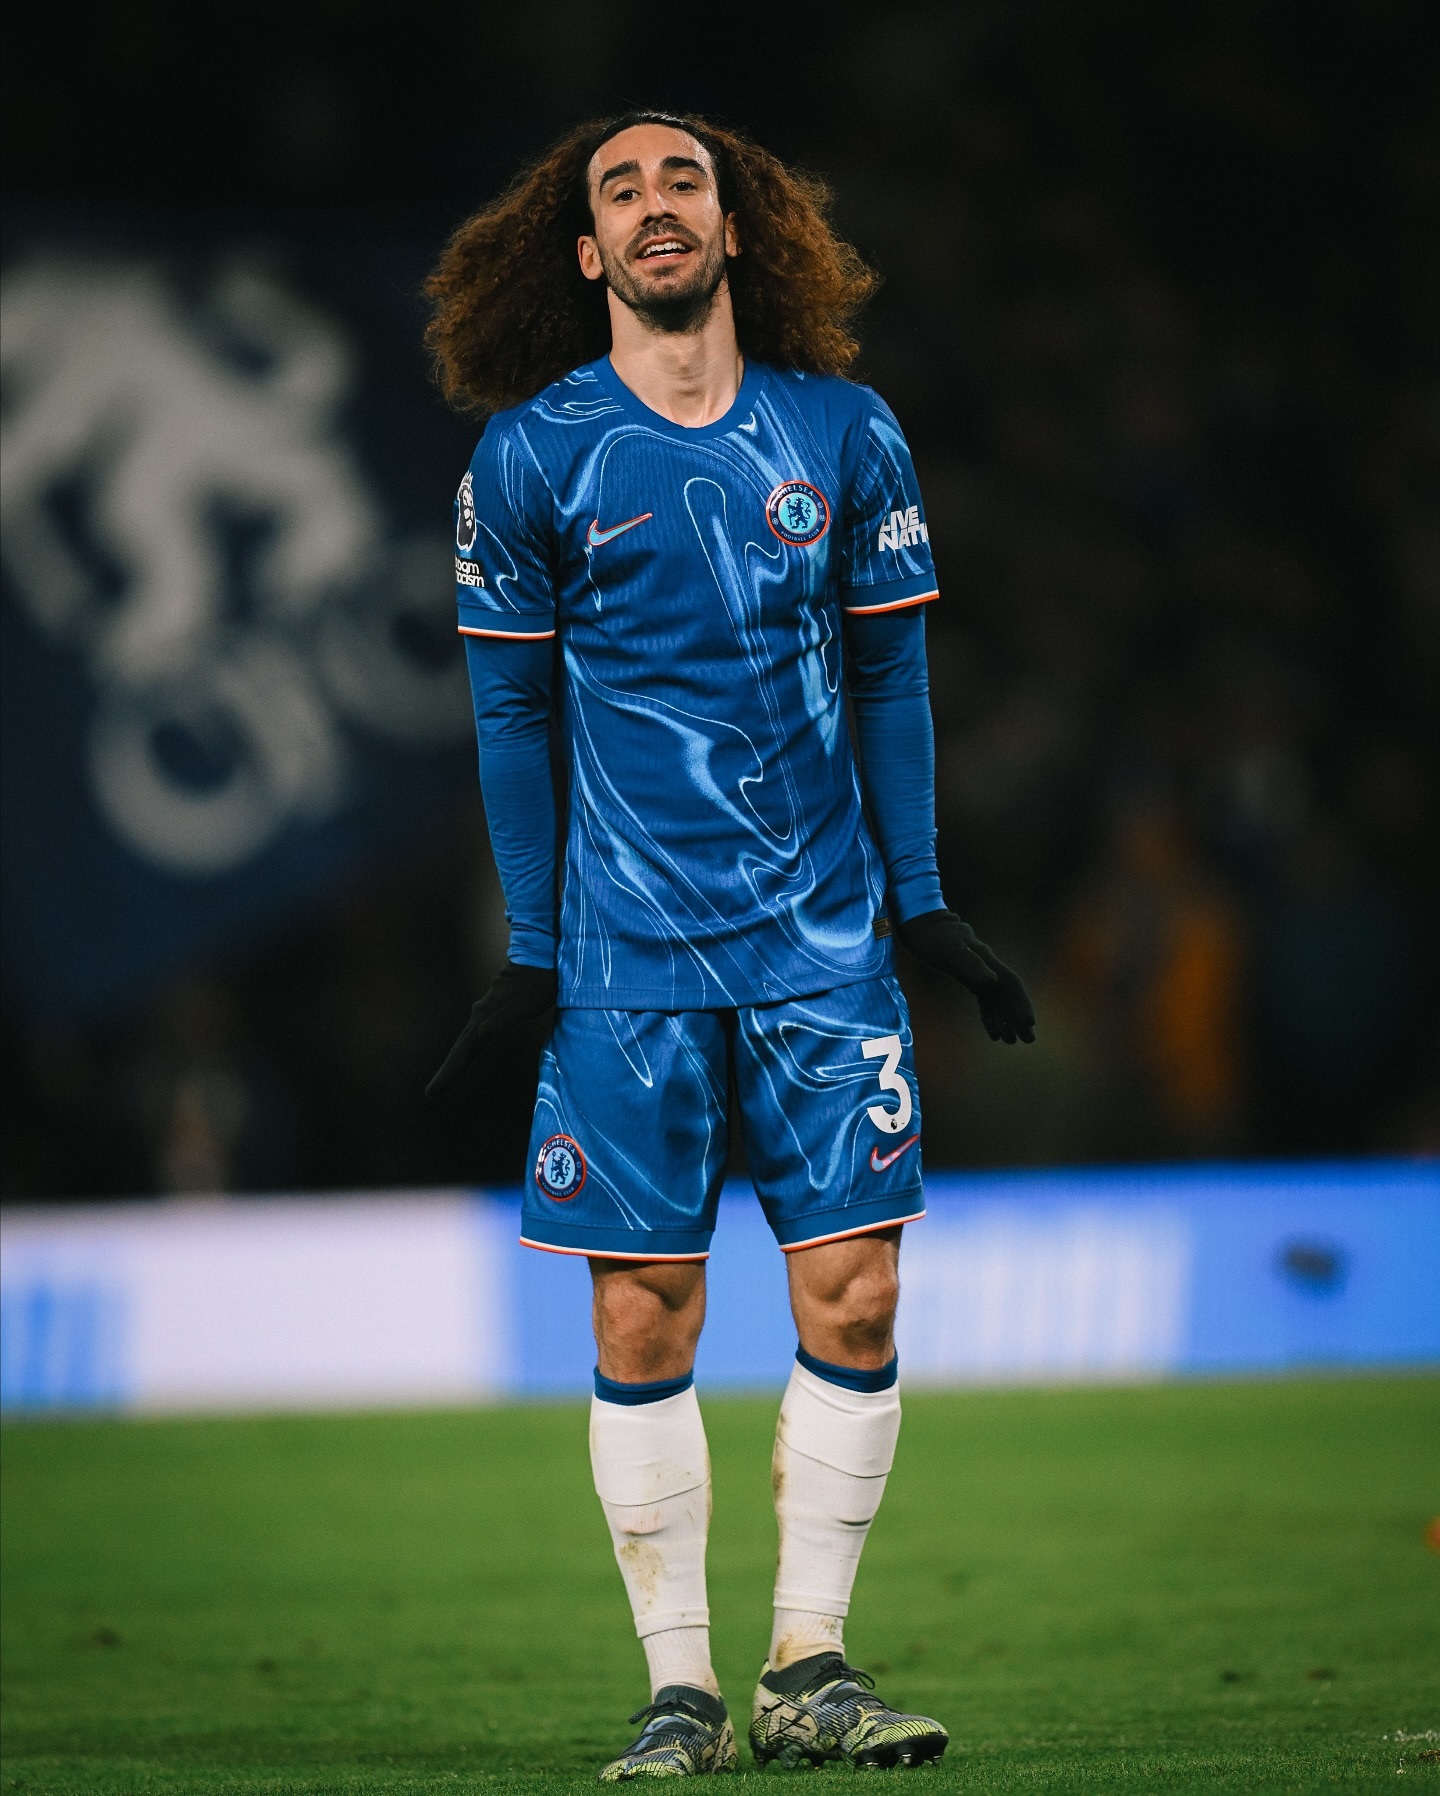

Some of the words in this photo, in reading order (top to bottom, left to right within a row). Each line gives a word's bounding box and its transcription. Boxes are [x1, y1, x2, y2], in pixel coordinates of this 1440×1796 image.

[880, 505, 919, 532] LIVE
[878, 522, 929, 552] NATI
[455, 556, 480, 575] oom
[456, 570, 485, 588] acism
[861, 1034, 912, 1134] 3
[547, 1138, 576, 1155] CHELSEA
